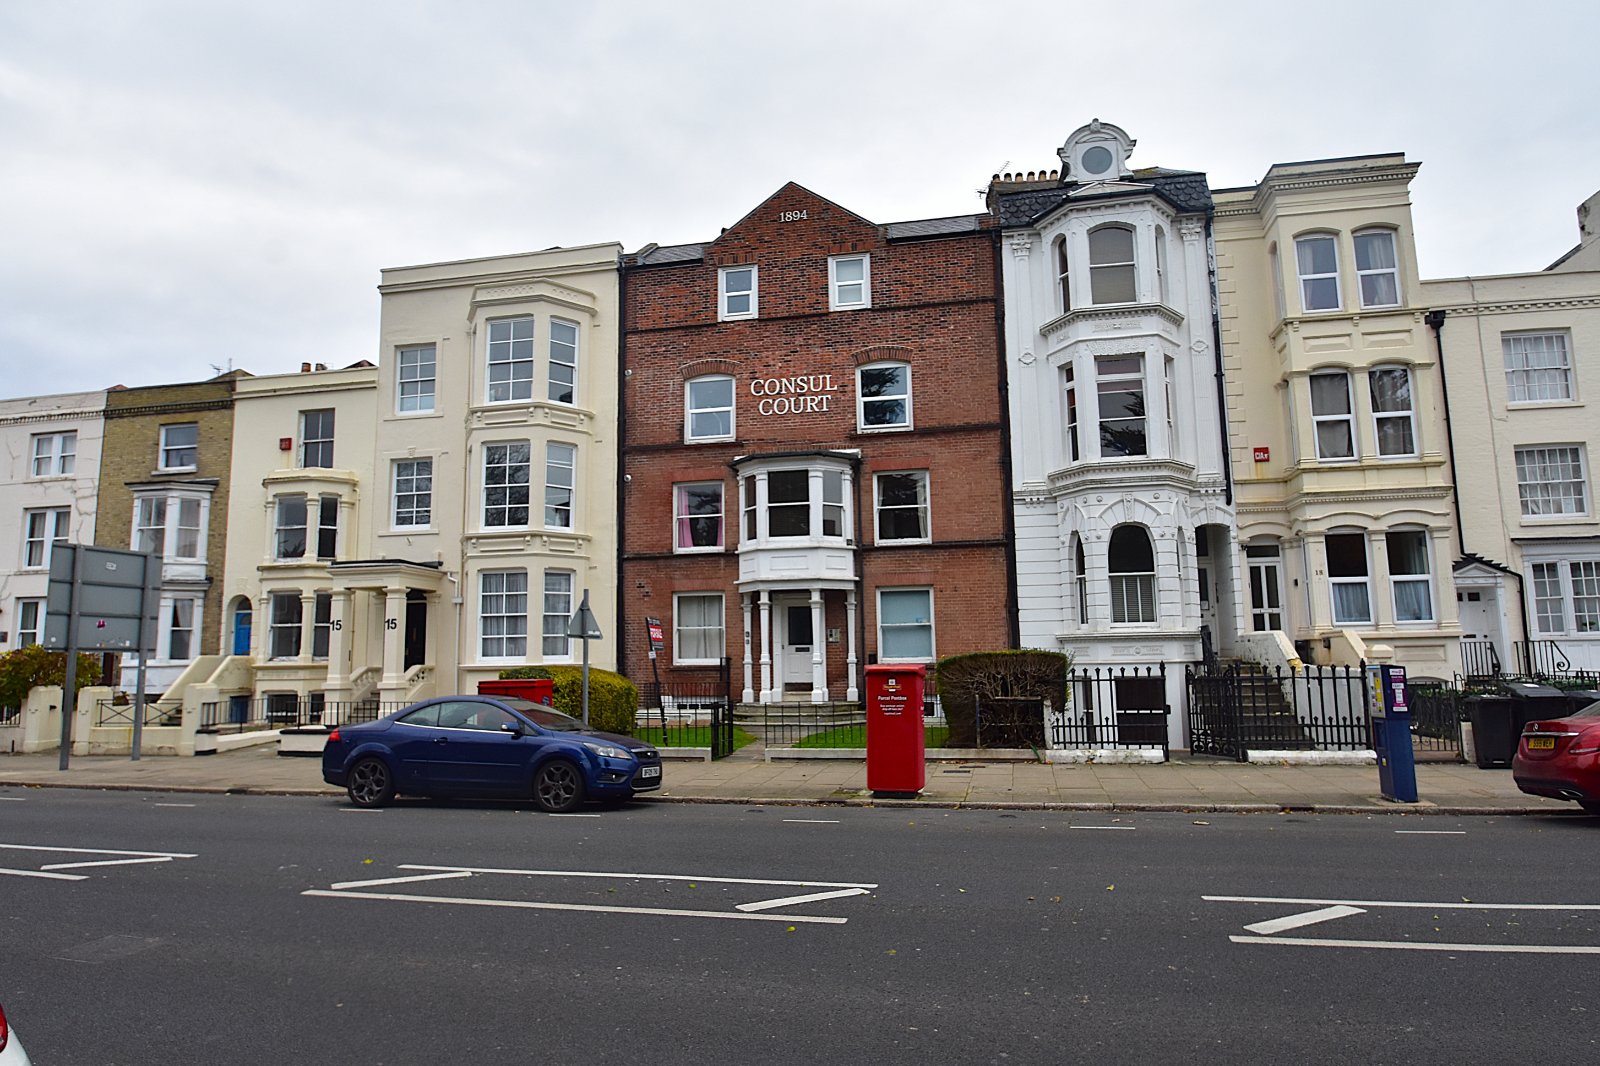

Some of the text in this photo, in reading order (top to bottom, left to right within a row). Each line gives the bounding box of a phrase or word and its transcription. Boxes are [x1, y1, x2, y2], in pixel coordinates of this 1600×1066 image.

[779, 210, 808, 222] 1894
[750, 374, 838, 396] CONSUL
[758, 395, 831, 415] COURT
[329, 619, 342, 631] 15
[384, 618, 398, 630] 15
